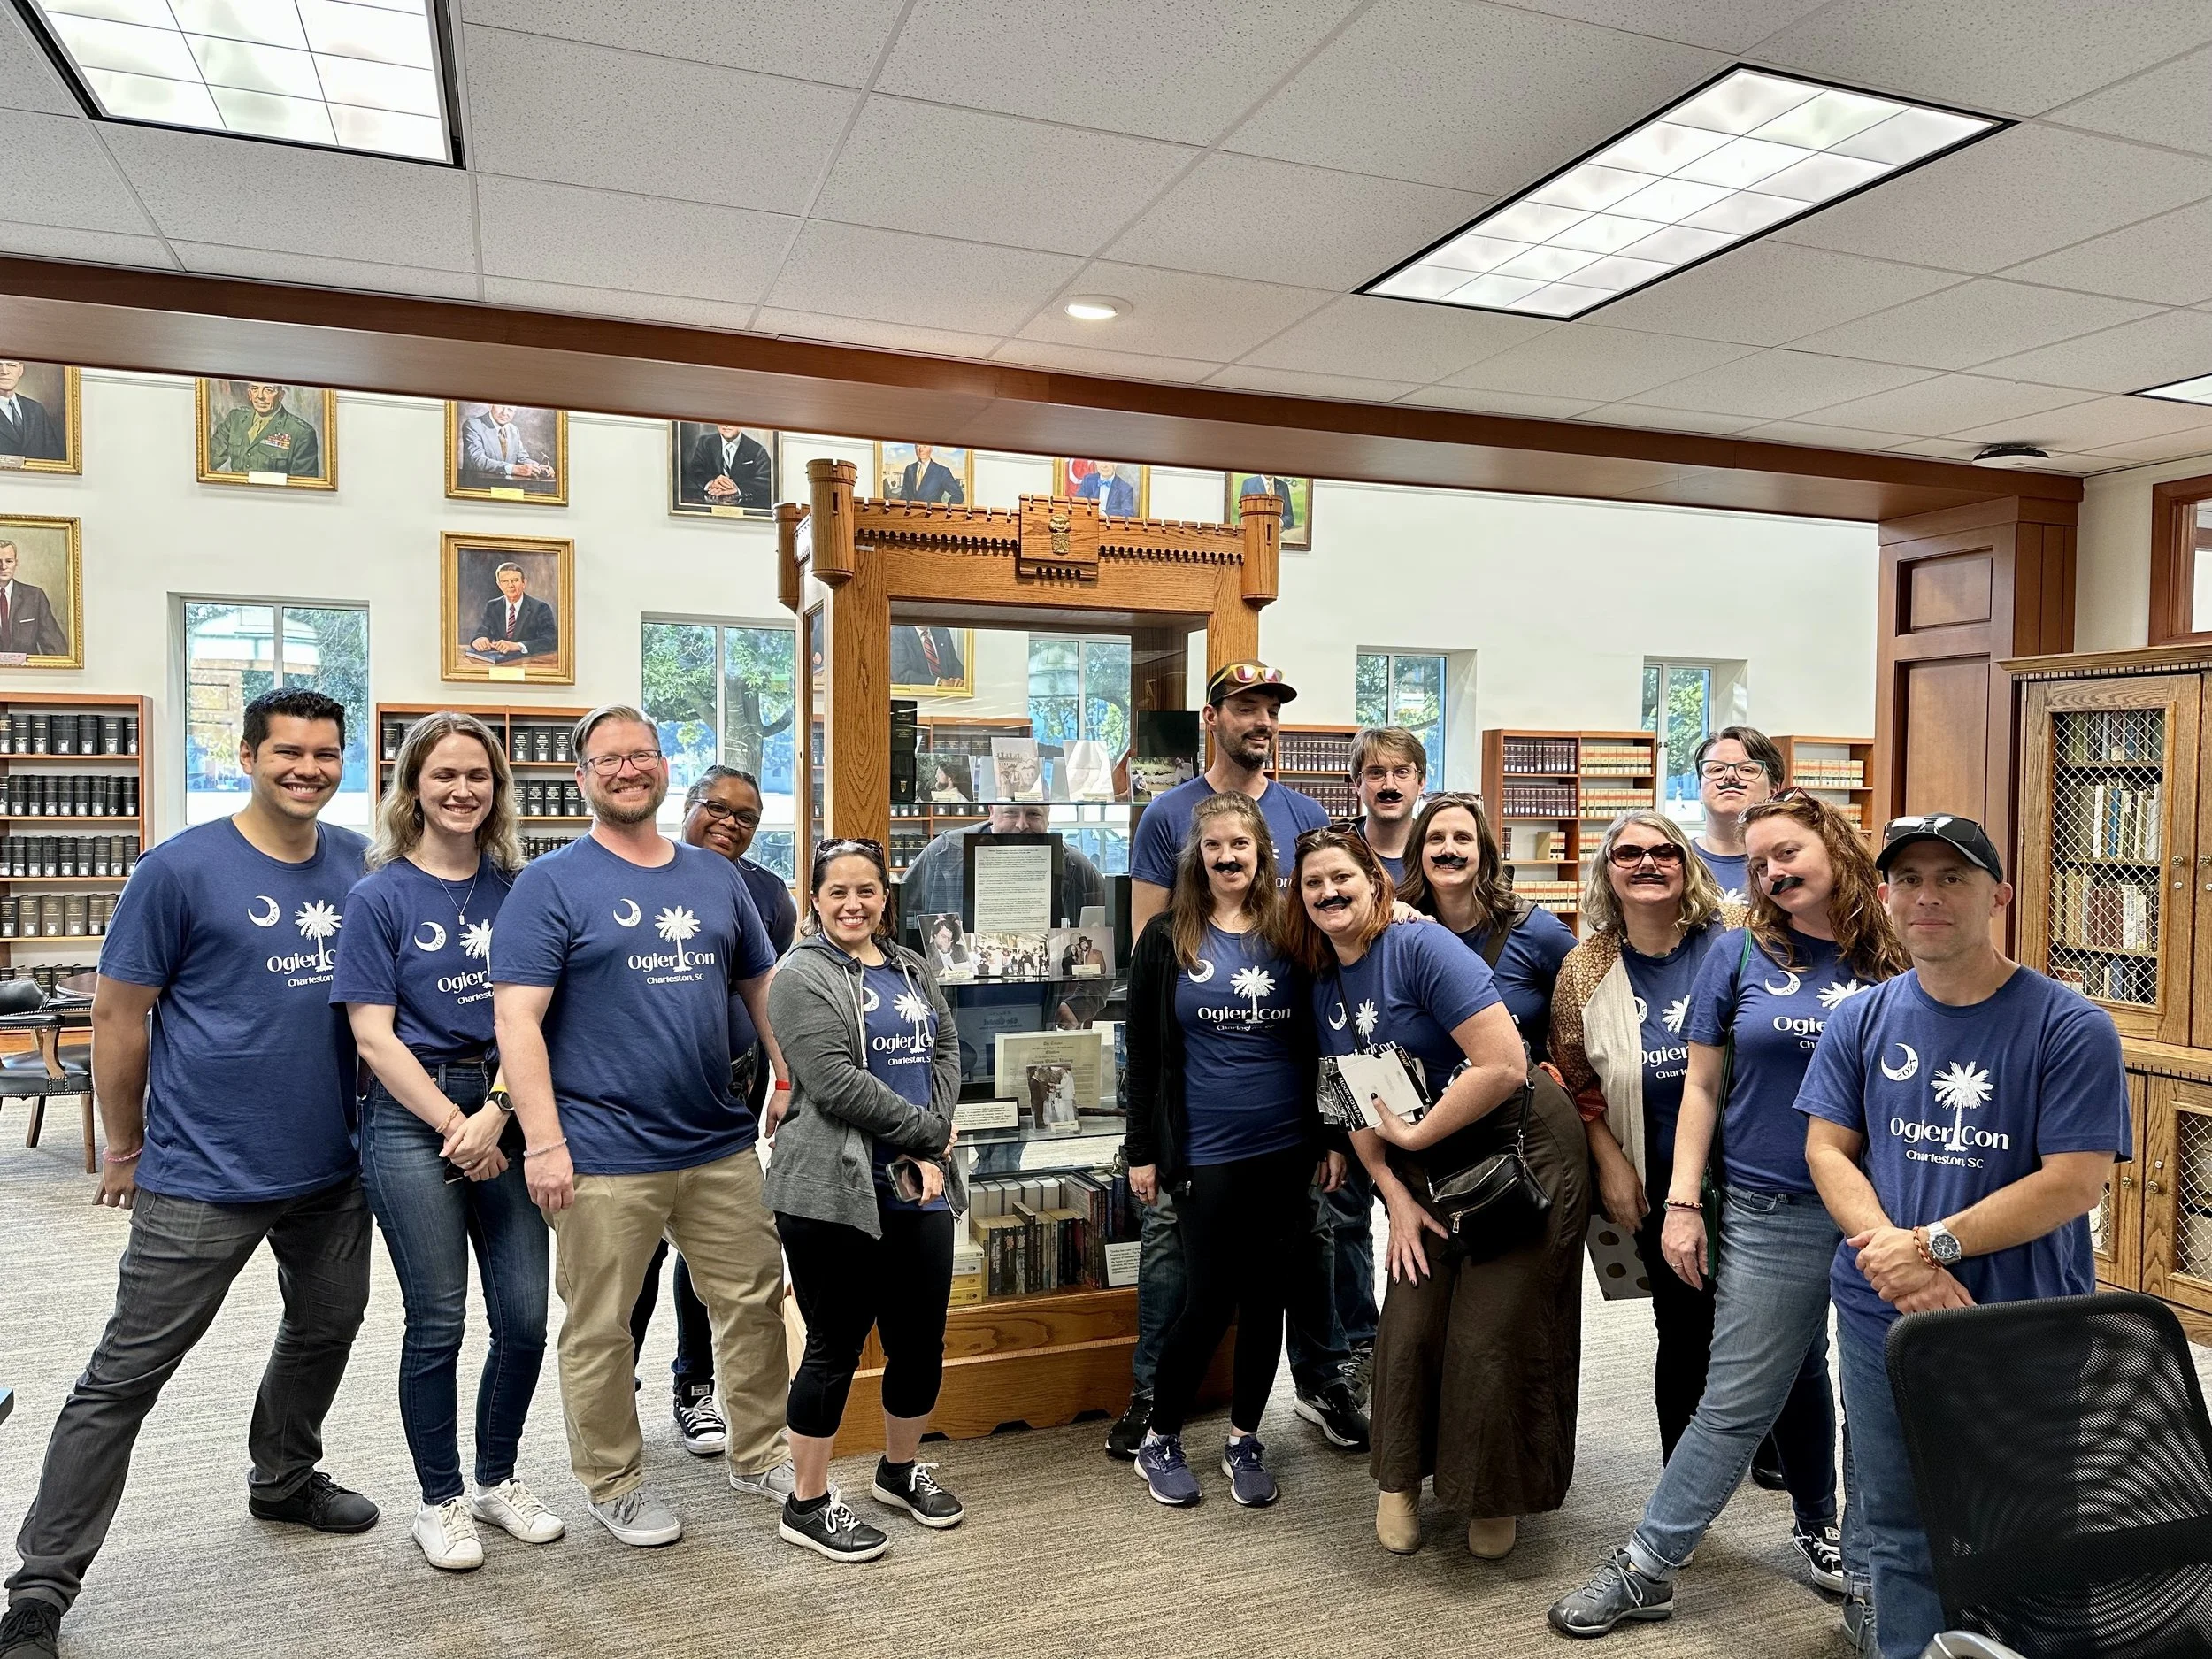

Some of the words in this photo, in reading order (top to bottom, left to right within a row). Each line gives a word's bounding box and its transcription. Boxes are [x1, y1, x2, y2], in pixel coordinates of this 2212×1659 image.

[1275, 877, 1292, 887] on
[266, 952, 319, 975] Ogier
[437, 970, 487, 994] Ogier
[647, 974, 694, 985] Charleston,
[457, 990, 494, 1004] Charlest
[1773, 1016, 1827, 1036] Ogie
[872, 1033, 915, 1055] Ogier
[887, 1056, 926, 1066] Charleston,
[1656, 1068, 1688, 1079] Charl
[1906, 1149, 1966, 1167] Charleston,
[1967, 1157, 1984, 1169] SC
